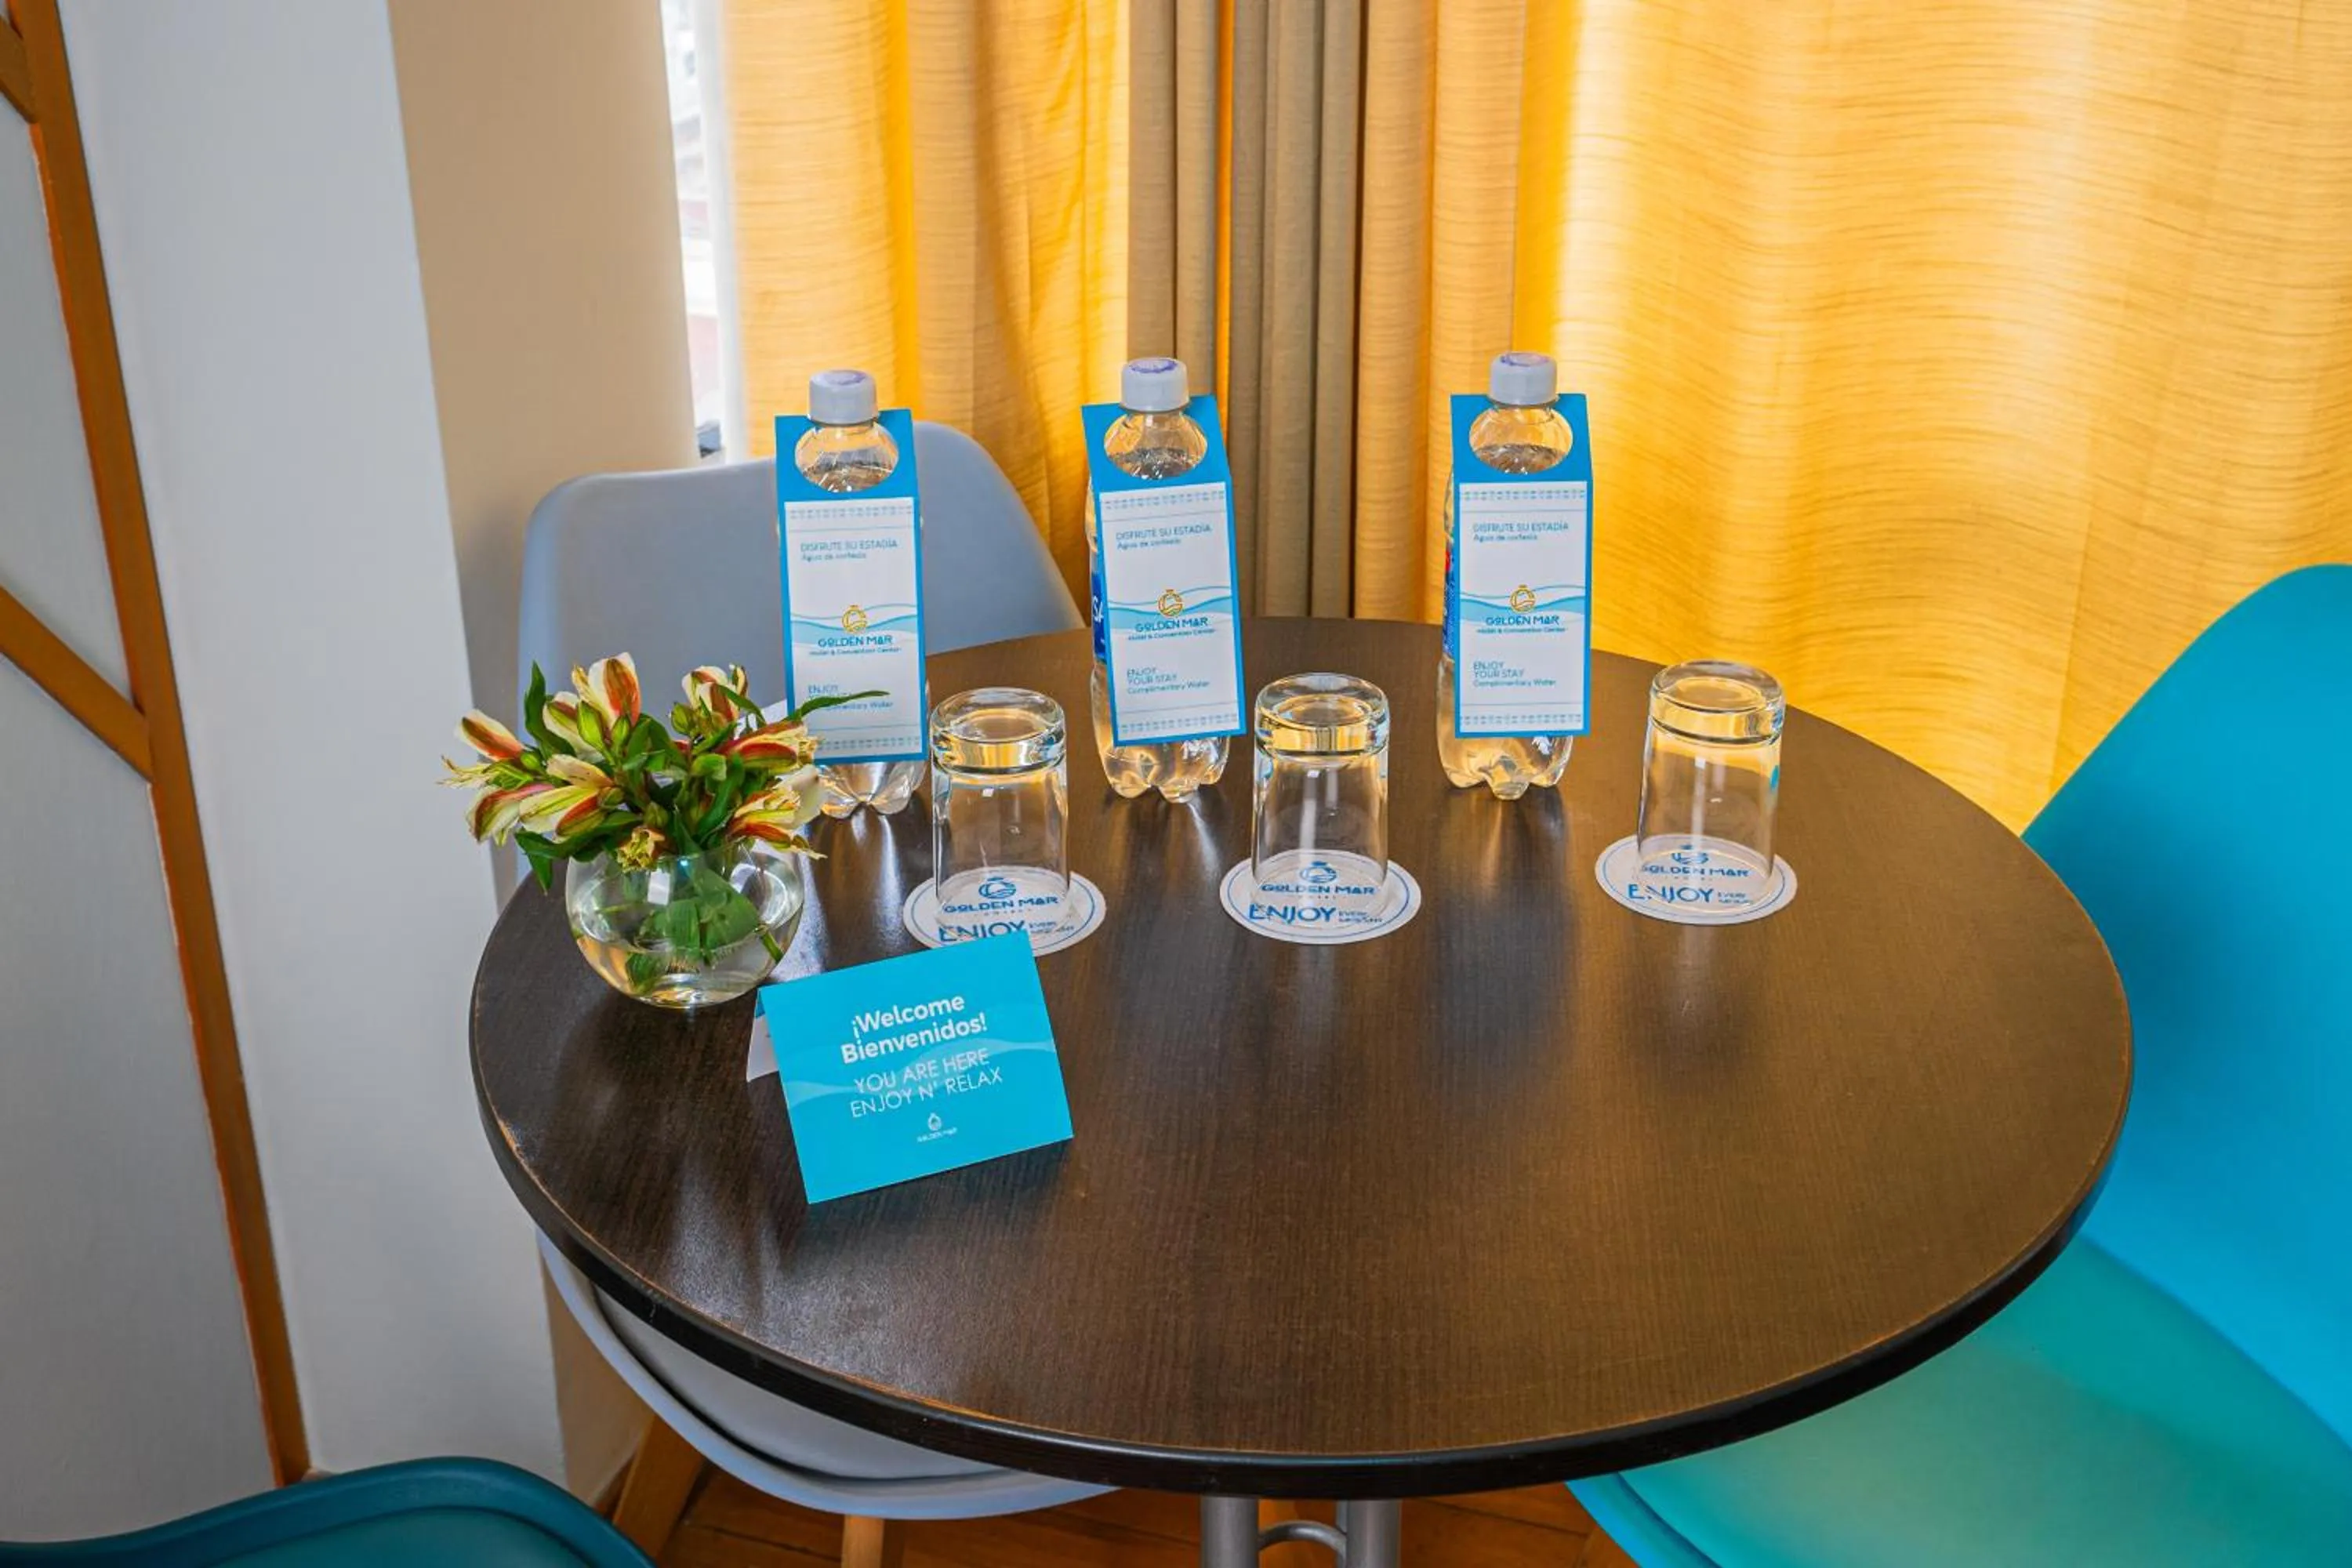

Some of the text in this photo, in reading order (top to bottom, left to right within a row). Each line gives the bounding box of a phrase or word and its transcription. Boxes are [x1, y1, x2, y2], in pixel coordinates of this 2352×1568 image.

[1134, 616, 1208, 633] GOLDEN MAR
[1486, 615, 1559, 626] GOLDEN MAR
[818, 634, 893, 648] GOLDEN MAR
[1127, 667, 1157, 677] ENJOY
[1474, 661, 1504, 670] ENJOY
[1128, 673, 1178, 686] YOUR STAY
[1474, 668, 1525, 679] YOUR STAY
[1186, 680, 1210, 688] Water
[1533, 678, 1556, 687] Water
[1709, 867, 1751, 877] MAR
[1261, 884, 1376, 895] GOLDEN MAR
[1628, 884, 1714, 903] ENJOY
[943, 900, 1014, 913] GOLDEN
[1018, 895, 1058, 907] MAR
[1248, 902, 1336, 925] ENJOY
[851, 994, 965, 1040] ¡Welcome
[840, 1012, 988, 1065] Bienvenidos!
[855, 1047, 990, 1094] YOU ARE HERE
[850, 1089, 914, 1119] ENJOY
[946, 1066, 1004, 1096] RELAX
